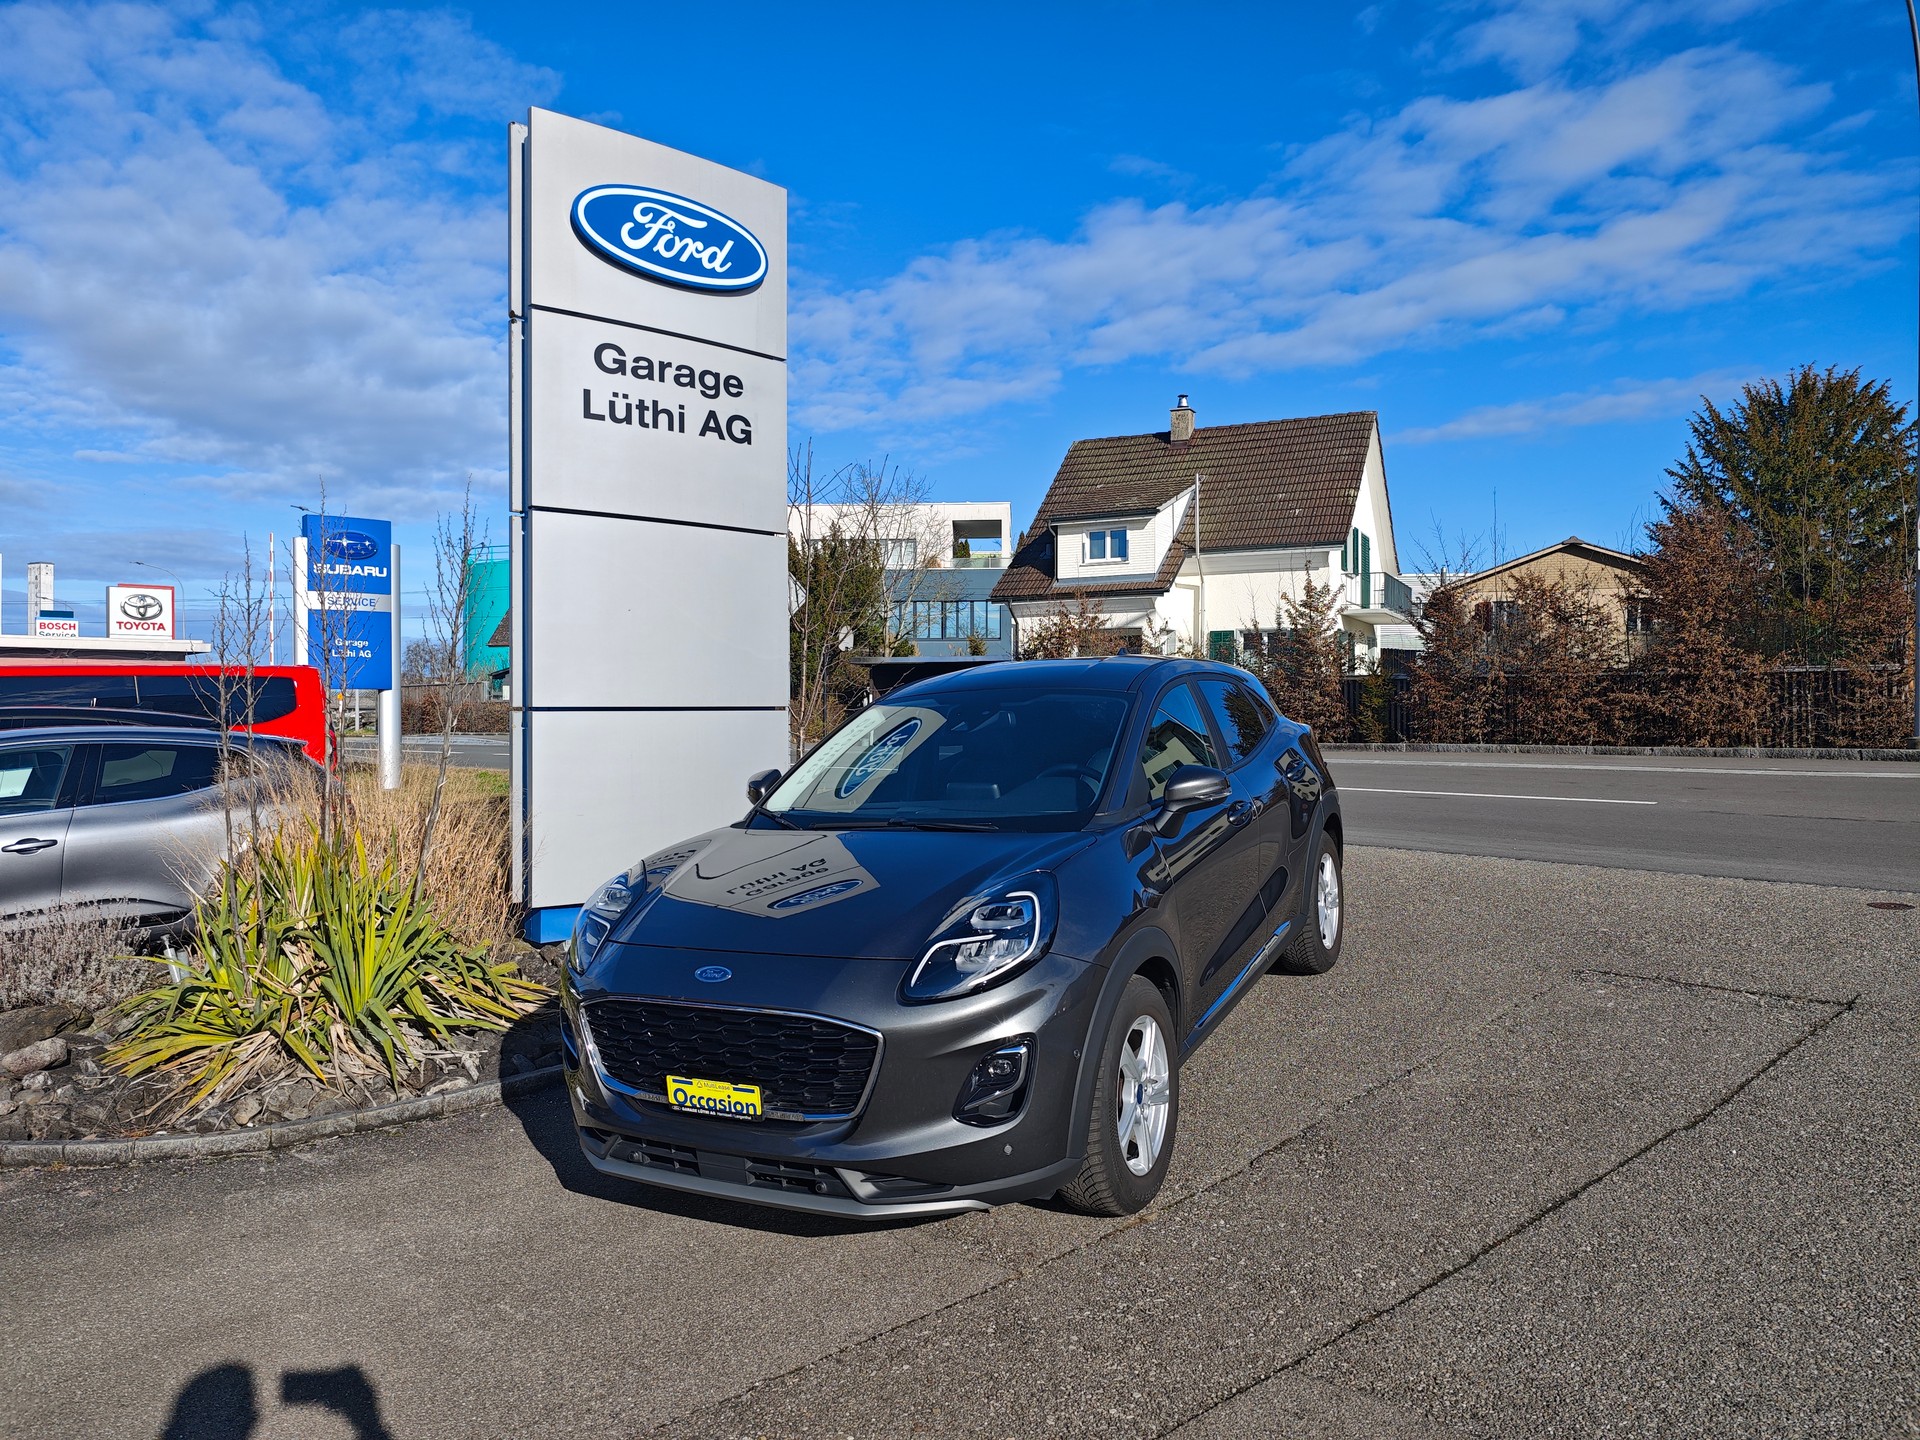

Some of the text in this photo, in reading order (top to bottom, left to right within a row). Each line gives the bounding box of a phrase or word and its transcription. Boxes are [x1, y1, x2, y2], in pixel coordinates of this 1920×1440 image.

[621, 202, 734, 273] Ford
[593, 342, 744, 399] Garage
[583, 388, 752, 445] Lüthi AG
[313, 563, 388, 578] SUBARU
[327, 596, 376, 607] SERVICE
[39, 622, 76, 630] BOSCH
[116, 621, 166, 631] TOYOTA
[332, 649, 372, 658] Lhi AG
[673, 1087, 757, 1115] Occasion
